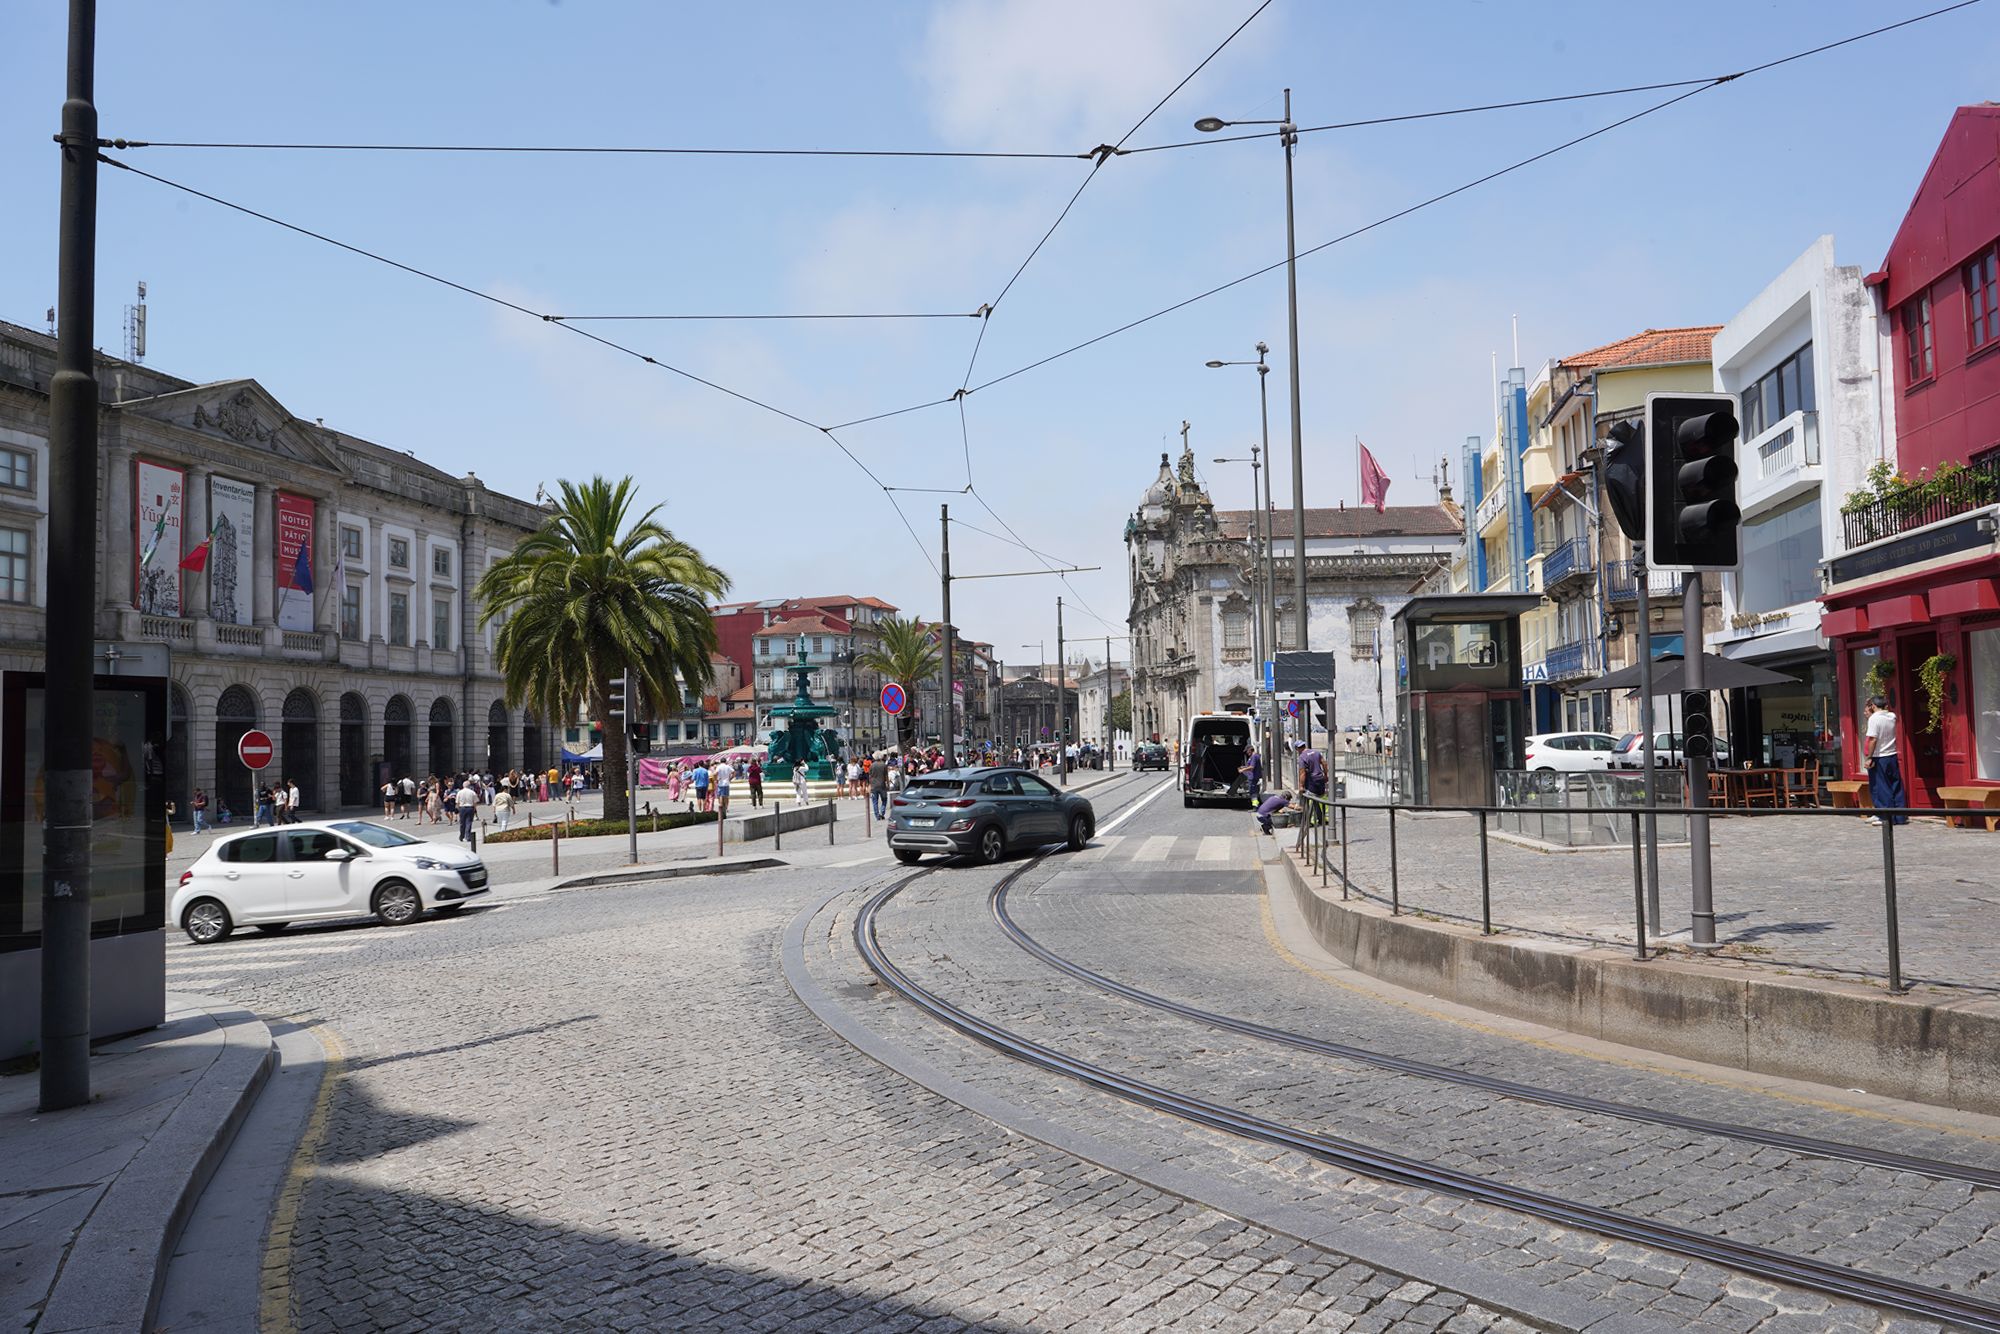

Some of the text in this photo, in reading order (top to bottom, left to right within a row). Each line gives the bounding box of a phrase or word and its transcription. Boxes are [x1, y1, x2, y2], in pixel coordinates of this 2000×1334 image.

[212, 480, 254, 498] Inventarium
[282, 514, 309, 526] NOITES
[284, 530, 307, 541] PÁTIO
[1919, 540, 1931, 552] AND
[1933, 533, 1958, 547] DESIGN
[283, 545, 302, 556] MUS
